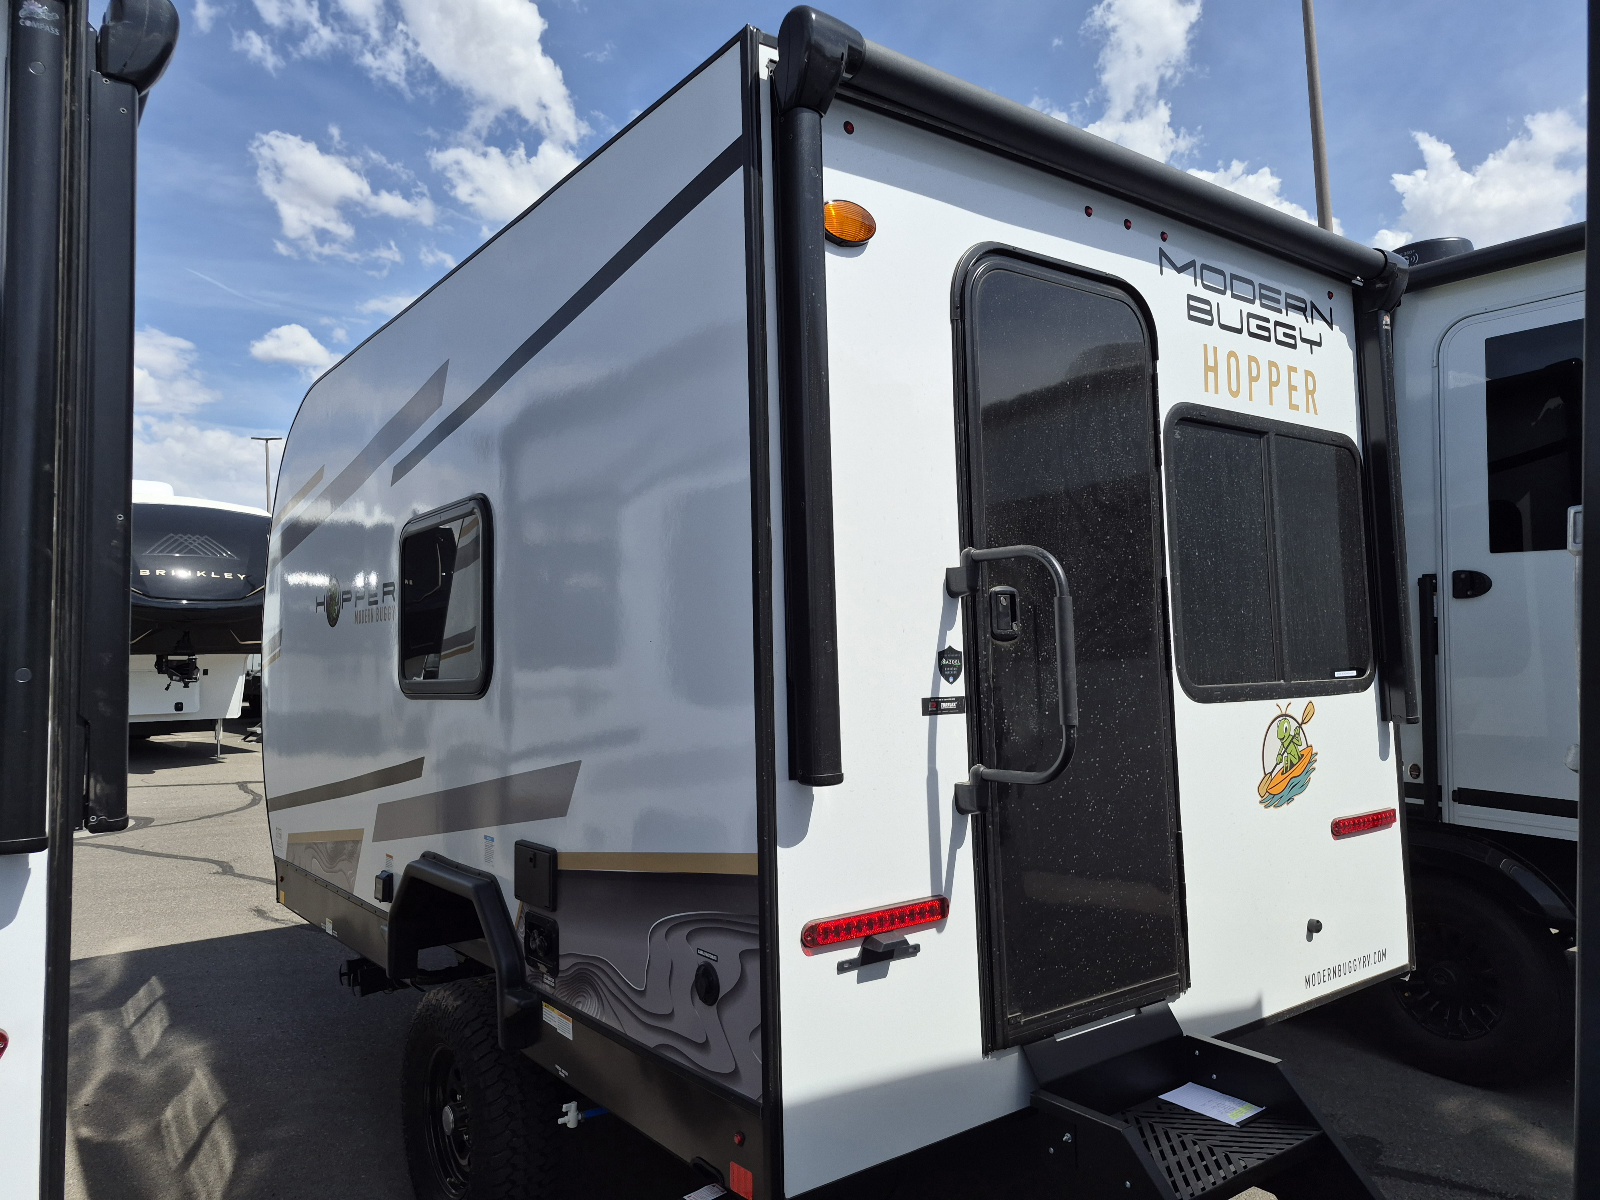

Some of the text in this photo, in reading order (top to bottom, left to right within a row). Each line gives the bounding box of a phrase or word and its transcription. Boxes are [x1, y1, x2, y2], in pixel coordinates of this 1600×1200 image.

[19, 19, 59, 36] COMPASS
[1158, 246, 1334, 331] MODERN
[1186, 293, 1322, 355] BUGGY
[1203, 343, 1318, 416] HOPPER
[139, 569, 246, 580] BRINKLEY
[354, 605, 395, 624] MODERN BUGGY
[1304, 947, 1387, 989] MODERNBUGGYRV.COM
